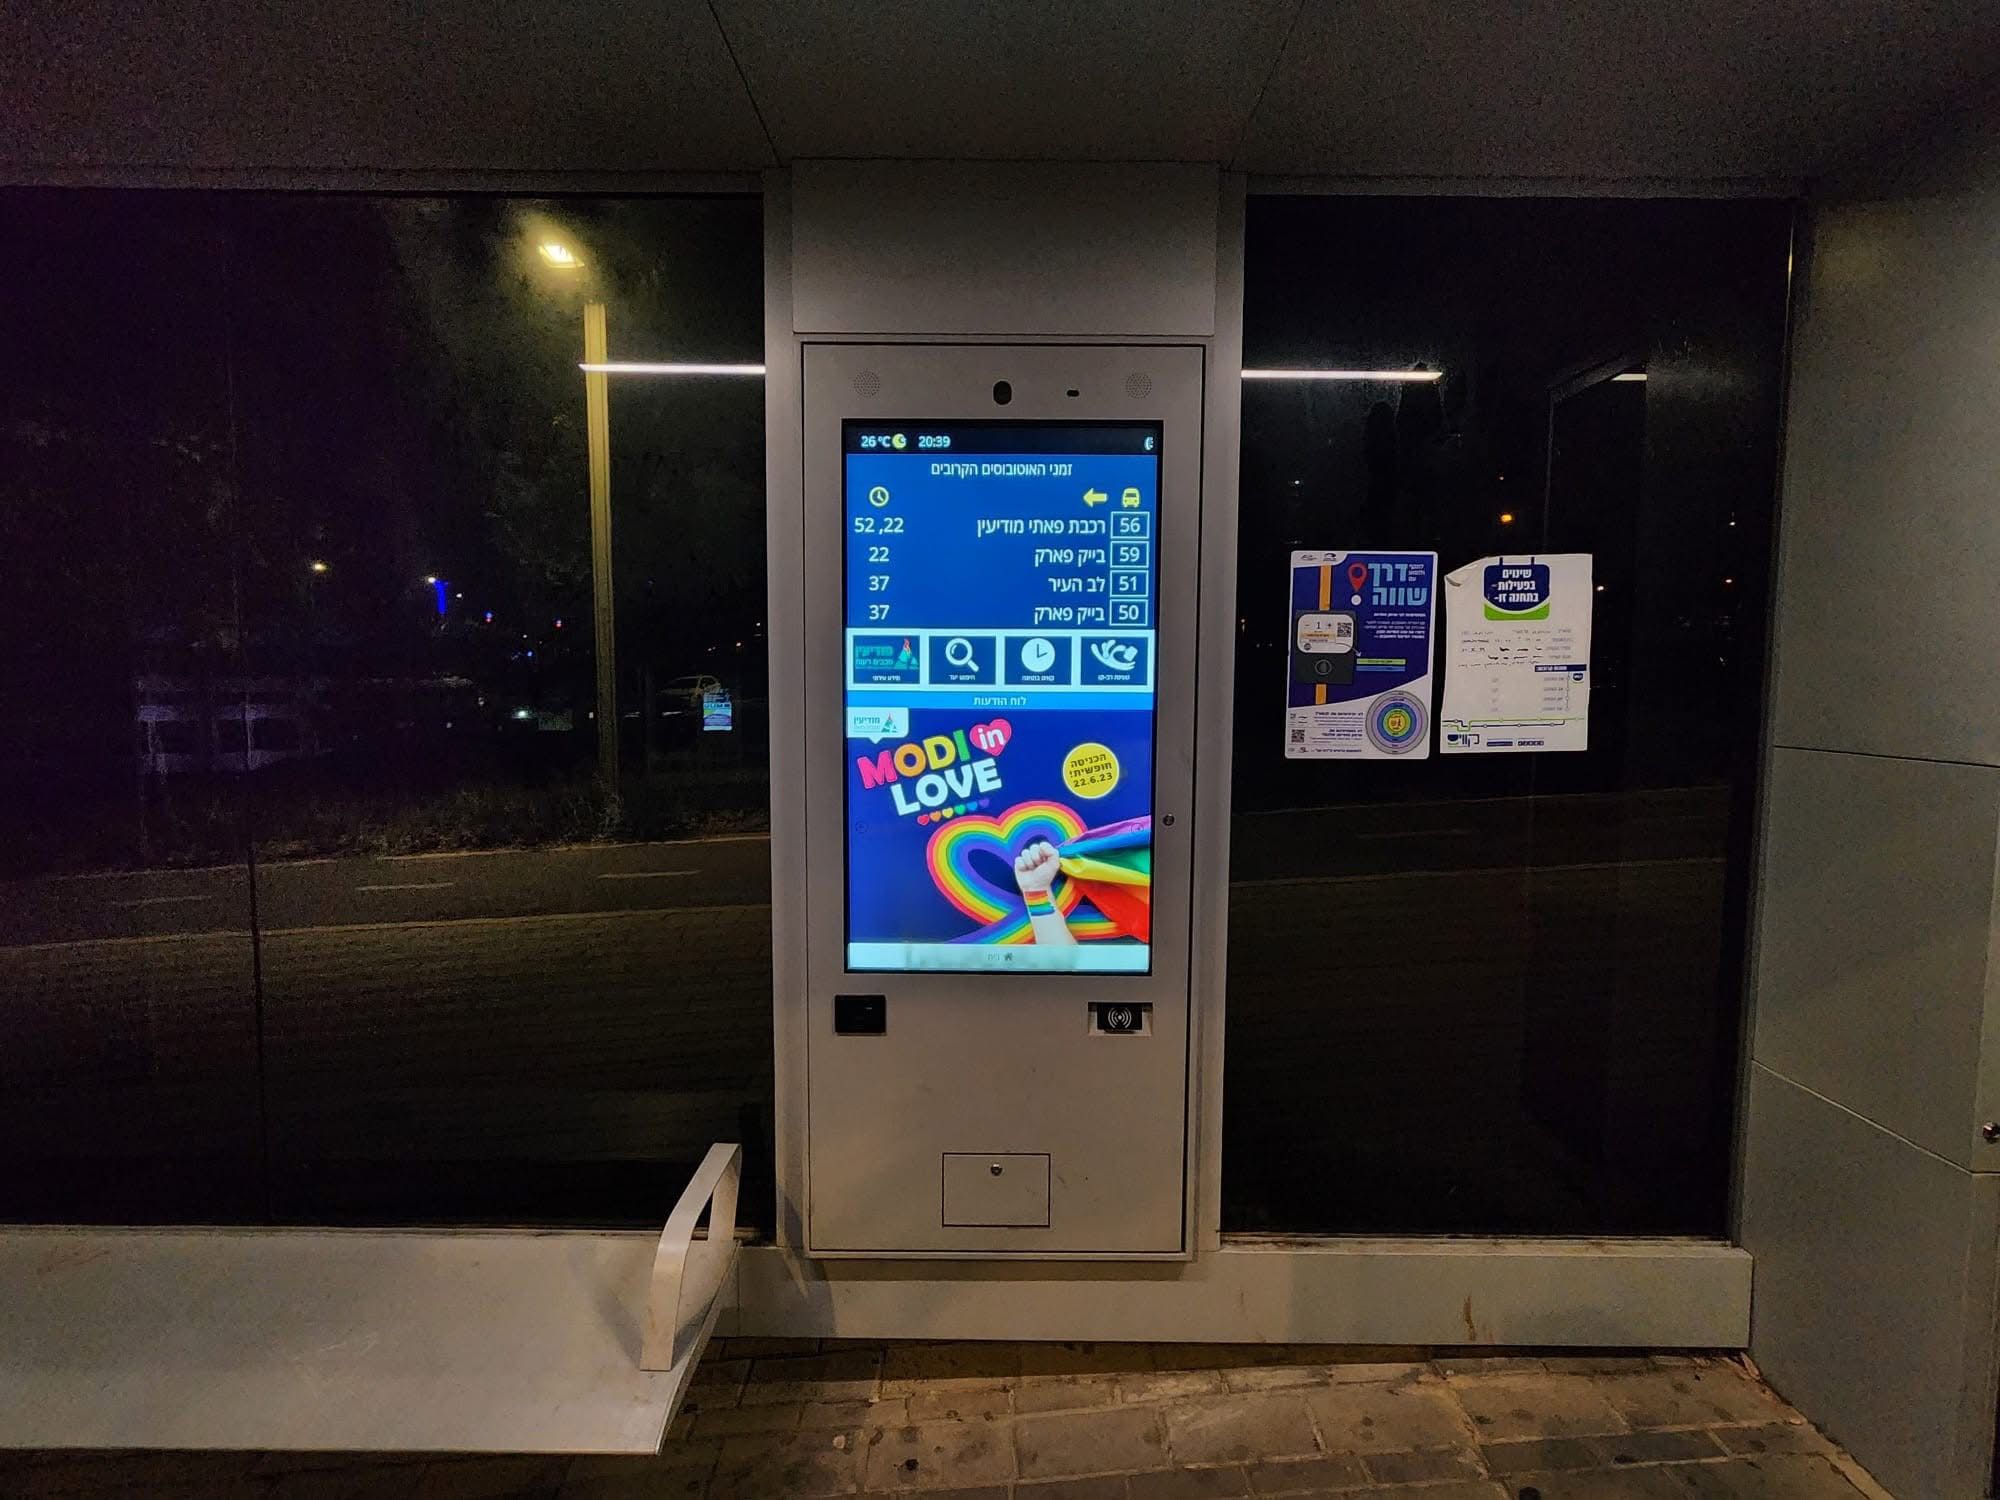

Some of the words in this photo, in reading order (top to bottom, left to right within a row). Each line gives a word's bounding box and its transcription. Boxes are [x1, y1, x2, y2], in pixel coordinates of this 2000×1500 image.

[861, 435, 877, 448] 26
[918, 435, 951, 448] 20:39
[931, 463, 978, 479] הקרובים
[981, 463, 1046, 476] האוטובוסים
[1049, 463, 1073, 476] זמני
[854, 517, 875, 533] 52
[977, 519, 1025, 538] מודיעין
[1028, 519, 1065, 534] פאתי
[1068, 519, 1106, 534] רכבת
[1119, 517, 1141, 533] 56
[868, 546, 890, 562] 22
[1034, 548, 1074, 568] פארק
[1078, 548, 1106, 568] בייק
[1119, 546, 1140, 562] 59
[868, 575, 890, 591] 37
[1118, 575, 1138, 591] 51
[1367, 563, 1409, 587] דרך
[1048, 577, 1083, 592] העיר
[1086, 575, 1106, 593] לב
[1372, 587, 1428, 606] שווה
[1508, 592, 1540, 603] בתחנה
[868, 604, 890, 620] 37
[1034, 606, 1073, 625] פארק
[1077, 606, 1105, 626] בייק
[1118, 605, 1140, 621] 50
[973, 697, 1007, 706] הודעות
[1010, 696, 1027, 706] לוח
[853, 716, 881, 724] מודיעין
[857, 728, 971, 790] MODI
[977, 727, 1007, 750] in
[1069, 753, 1107, 768] הכניסה
[1068, 761, 1113, 778] חופשית!
[889, 756, 1003, 817] LOVE
[1072, 771, 1113, 788] 22.6.23
